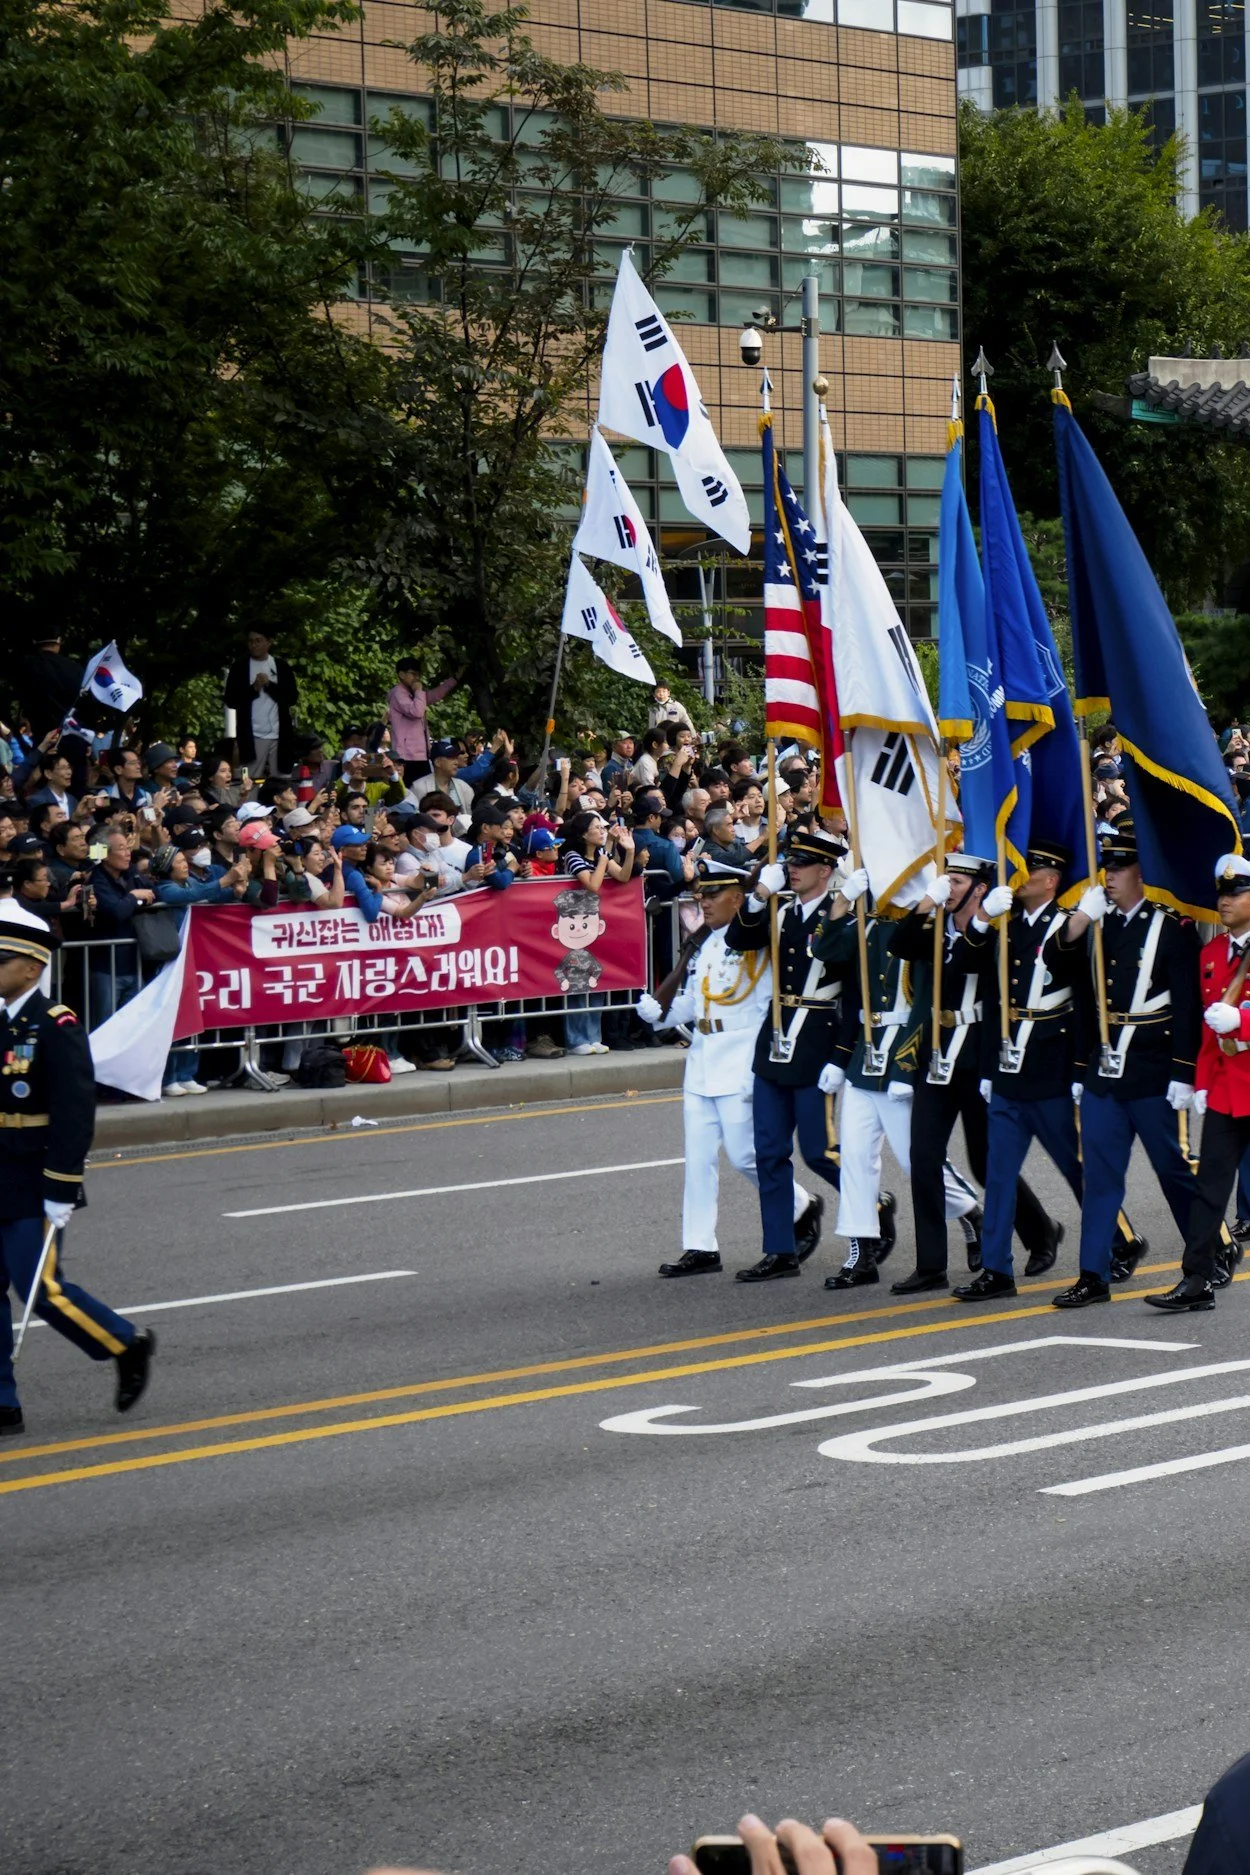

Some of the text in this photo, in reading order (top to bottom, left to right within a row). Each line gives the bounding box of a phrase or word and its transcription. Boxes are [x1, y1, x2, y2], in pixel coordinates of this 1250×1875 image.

[271, 917, 360, 949] 귀신잡는
[263, 963, 327, 1005] 국군
[335, 946, 519, 1001] 자랑스러워요!
